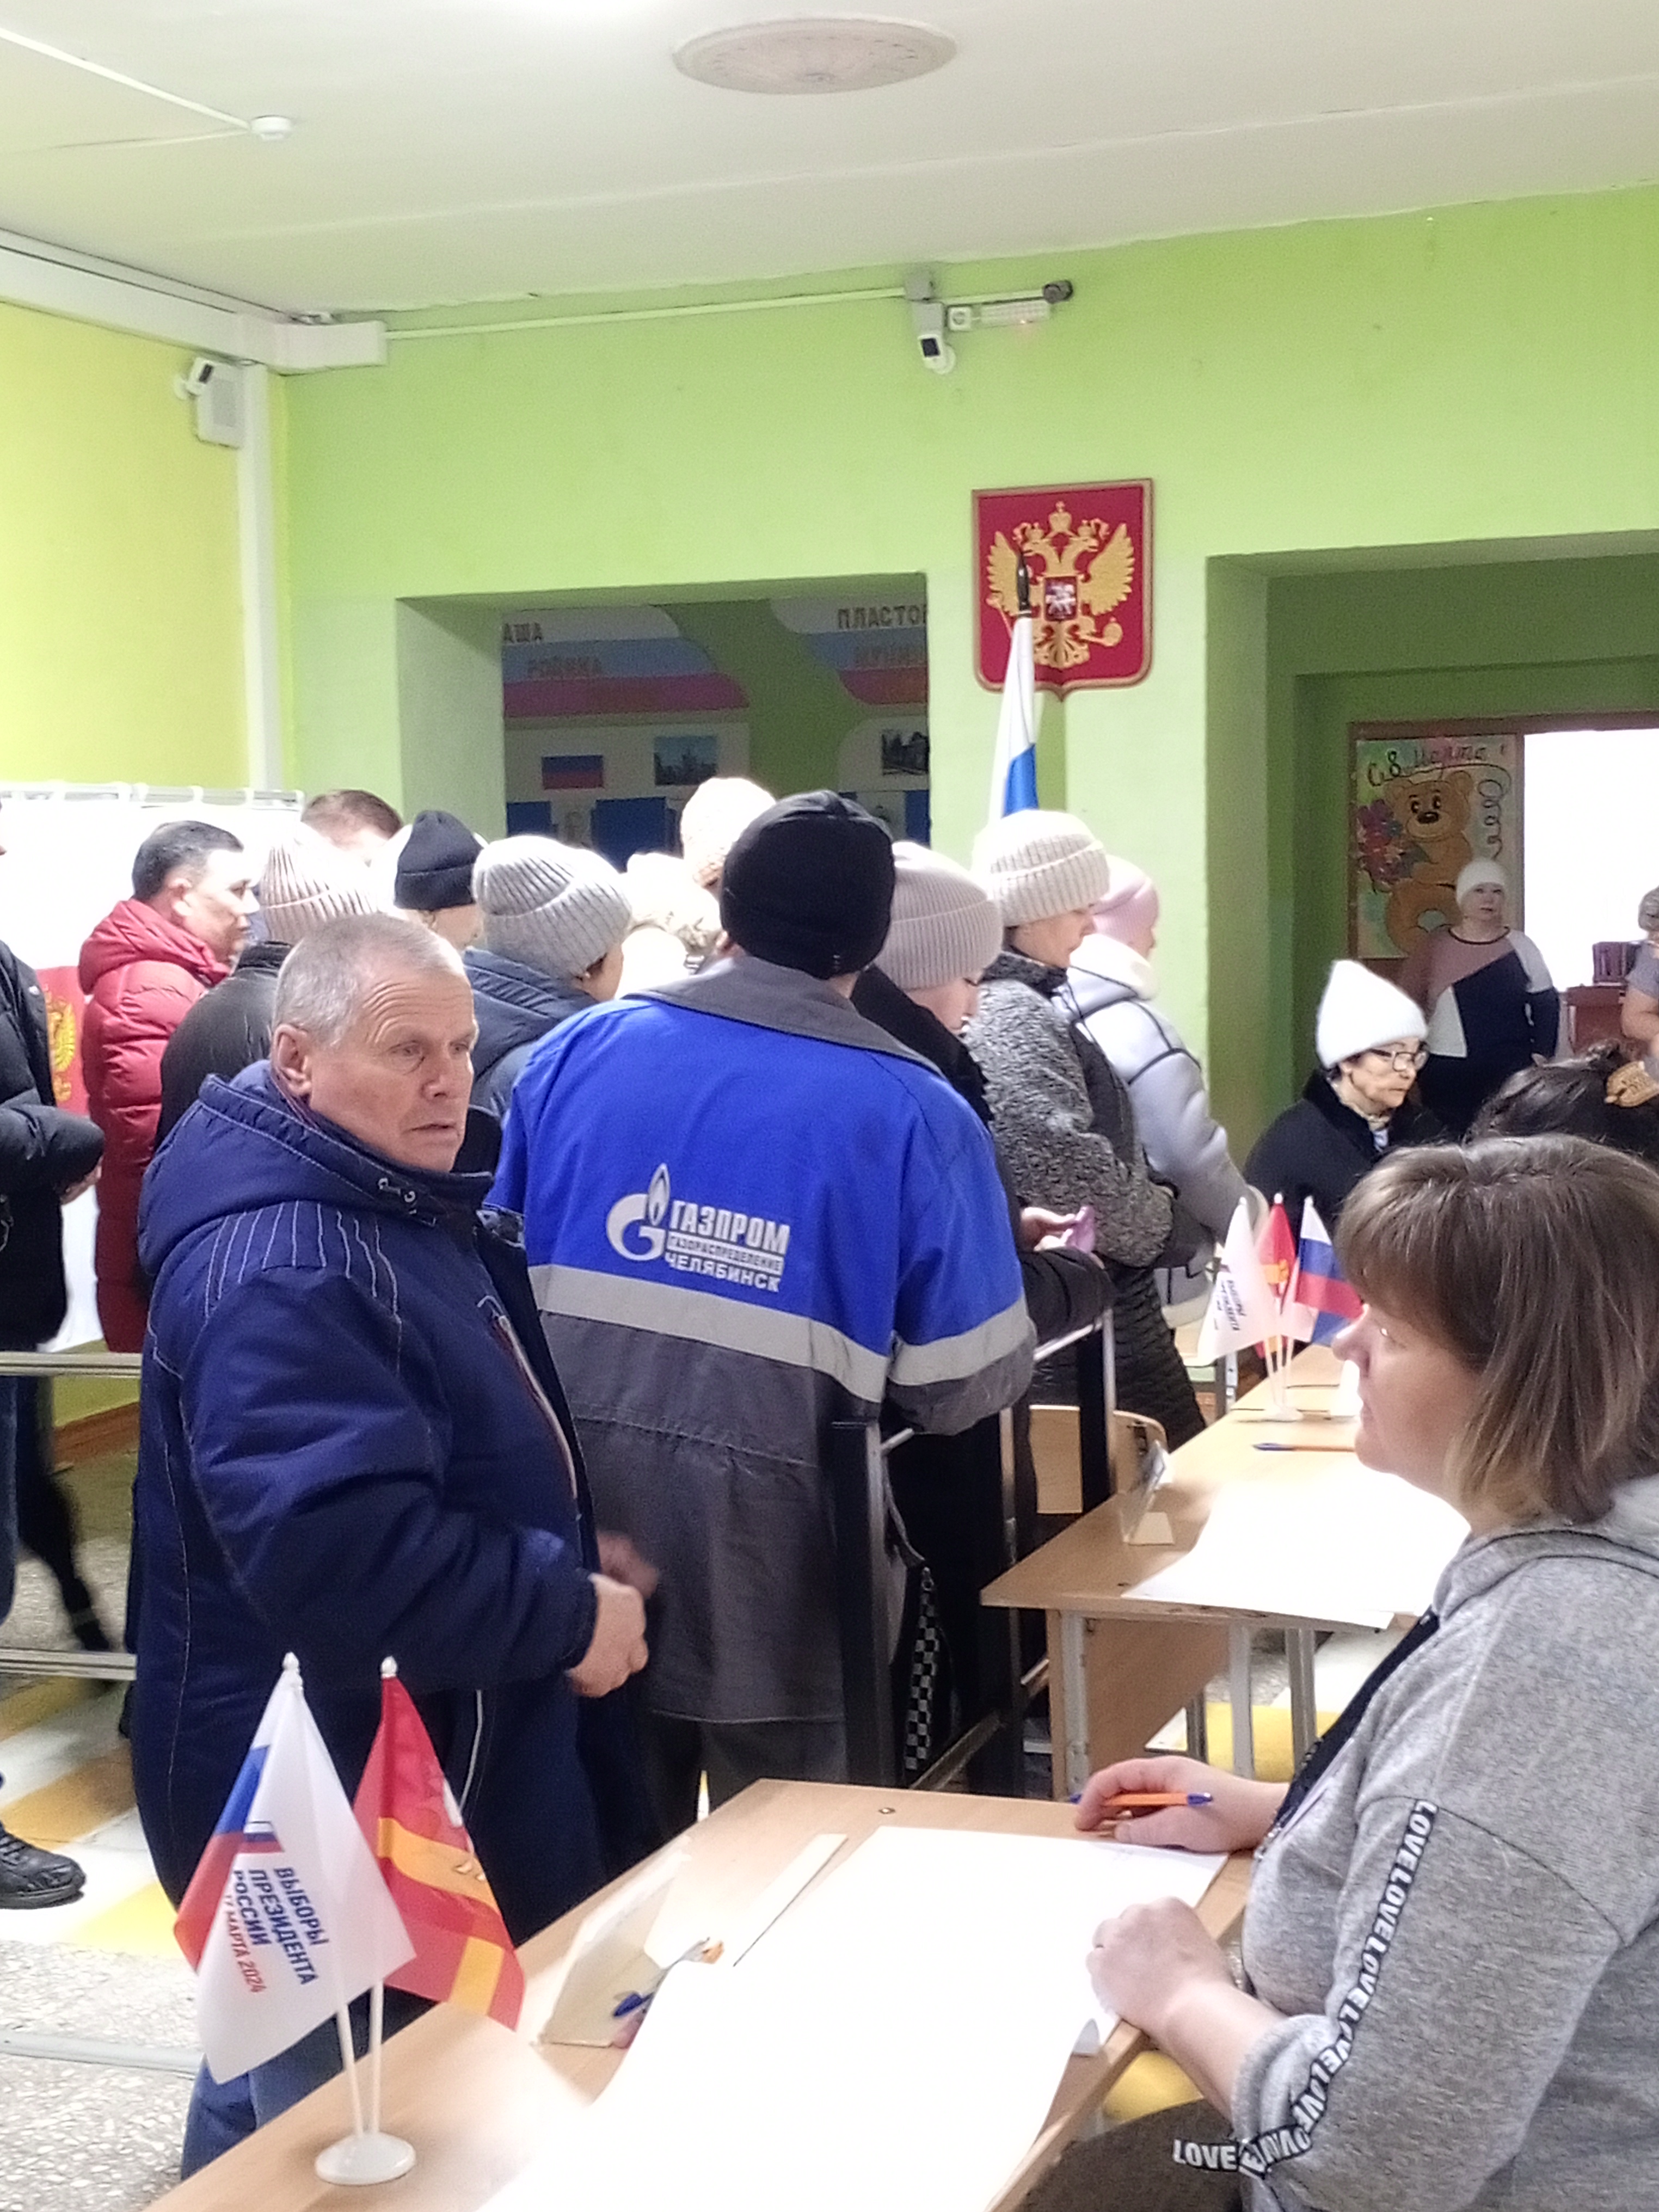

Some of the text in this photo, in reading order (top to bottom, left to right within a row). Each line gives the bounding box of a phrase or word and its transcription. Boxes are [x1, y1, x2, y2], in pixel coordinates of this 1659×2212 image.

[837, 605, 927, 630] ПЛАСТО
[1387, 750, 1402, 778] 8
[669, 1200, 790, 1255] ГАЗПРОМ
[665, 1251, 781, 1293] ЧЕЛЯБИНСК
[1397, 1800, 1439, 1872] LOVE
[234, 1870, 272, 1945] РОССИИ
[248, 1870, 318, 1985] ПРЕЗИДЕНТА
[274, 1867, 329, 1946] ВЫБОРЫ
[1373, 1867, 1413, 1941] LOVE
[1347, 1936, 1388, 2009] LOVE
[1173, 2139, 1238, 2170] LOVE
